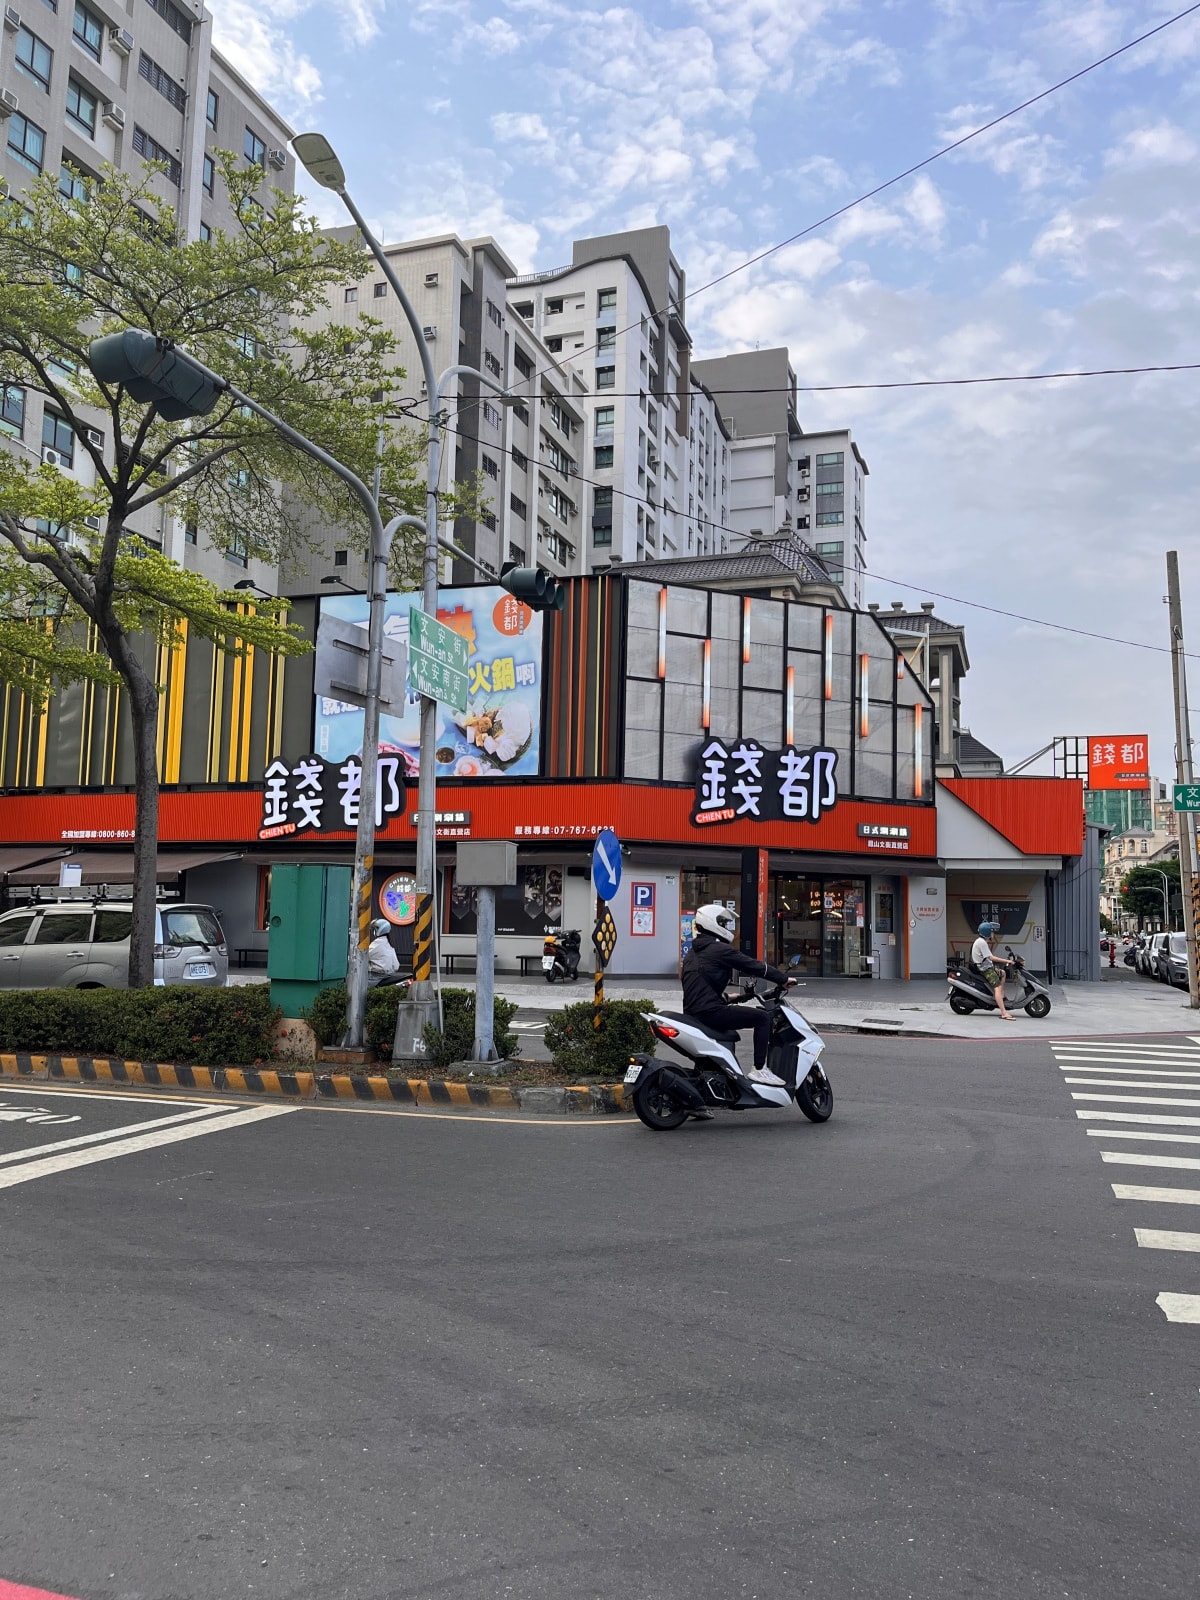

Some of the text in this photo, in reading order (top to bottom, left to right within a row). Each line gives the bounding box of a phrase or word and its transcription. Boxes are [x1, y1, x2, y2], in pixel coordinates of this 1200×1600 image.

[420, 616, 462, 655] 文安街
[420, 635, 446, 661] Wun-an
[417, 674, 443, 699] Wun-an
[419, 656, 461, 693] 文安南街
[469, 657, 536, 696] 火鍋啊
[1092, 742, 1145, 765] 錢都
[263, 757, 400, 828] 錢都
[700, 741, 836, 819] 錢都
[1186, 786, 1199, 798] 文
[636, 886, 650, 905] P
